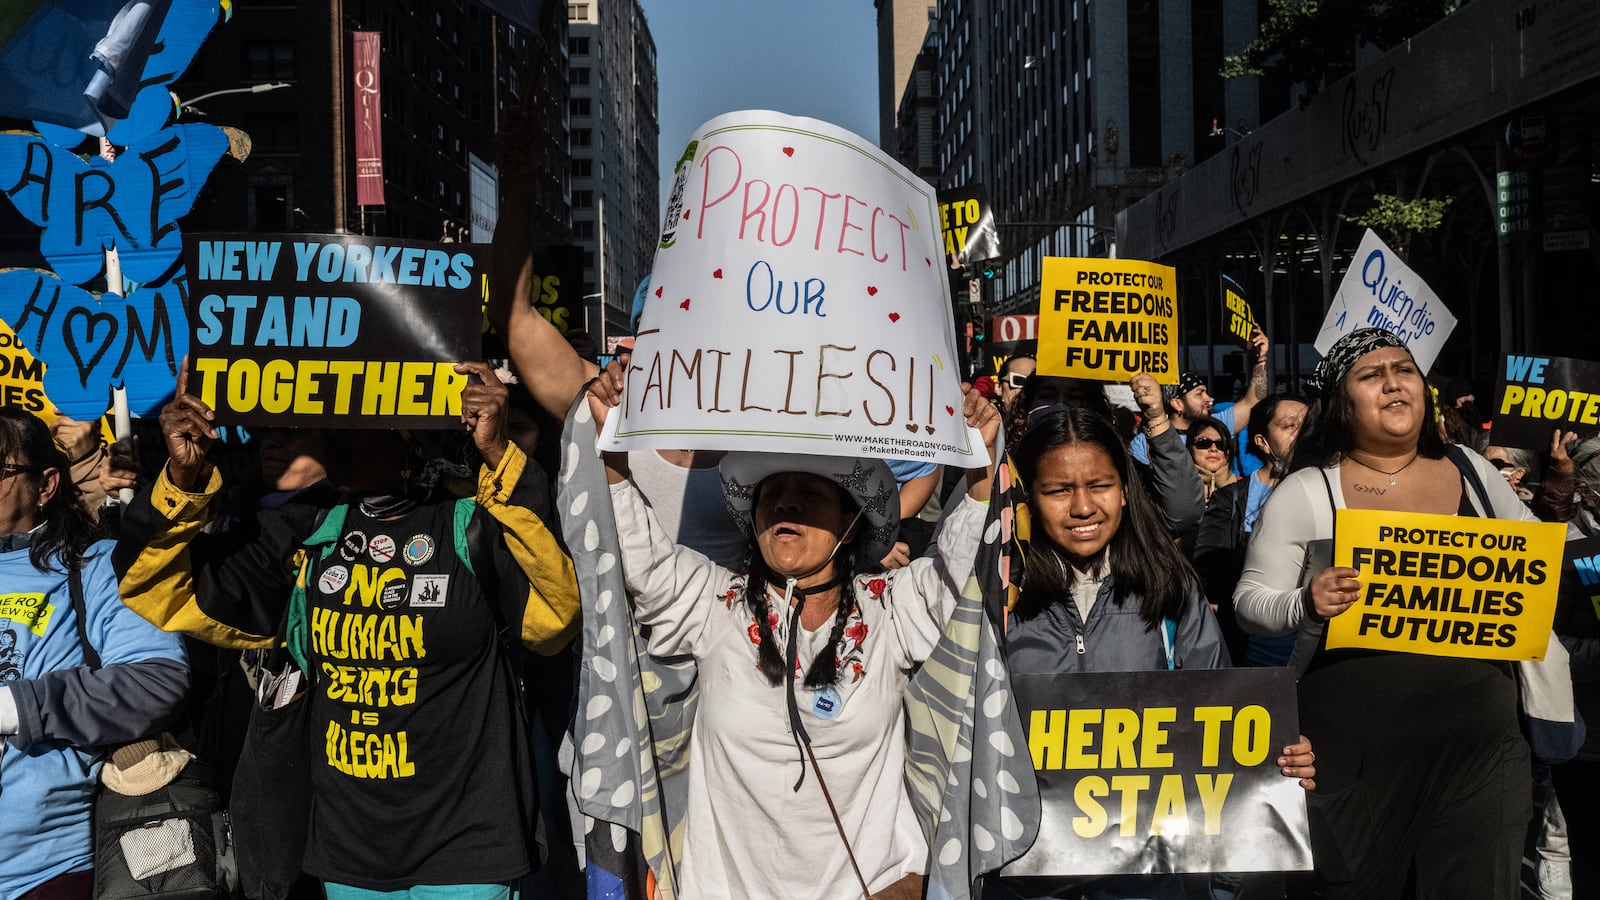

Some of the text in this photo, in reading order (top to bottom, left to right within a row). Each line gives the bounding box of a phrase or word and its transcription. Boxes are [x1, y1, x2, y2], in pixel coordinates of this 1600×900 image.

[7, 136, 183, 250] ARE
[697, 145, 912, 272] PROTECT
[952, 198, 981, 227] TO
[198, 241, 475, 290] NEW YORKERS
[1076, 271, 1163, 291] PROTECT OUR
[746, 260, 827, 318] OUR
[1362, 249, 1414, 321] Quien
[1053, 289, 1173, 318] FREEDOMS
[1226, 288, 1247, 319] HERE
[196, 295, 362, 349] STAND
[1066, 319, 1169, 346] FAMILIES
[1230, 313, 1253, 343] STAY
[1066, 346, 1169, 374] FUTURES
[1505, 354, 1551, 385] WE
[195, 357, 469, 417] TOGETHER
[1499, 384, 1600, 426] PROTE
[834, 434, 958, 453] WWW.MAKETHEROADNY.ORG
[860, 445, 937, 459] @MaketheRoadNY
[373, 537, 388, 546] STOP
[1378, 525, 1527, 552] PROTECT OUR
[1352, 546, 1547, 586] FREEDOMS
[1364, 582, 1525, 617] FAMILIES
[311, 606, 426, 661] HUMAN
[1358, 612, 1518, 648] FUTURES
[322, 661, 419, 708] BEING
[350, 709, 380, 726] IS
[325, 719, 416, 780] ILLEGAL
[1028, 704, 1272, 771] HERE TO
[1071, 773, 1235, 839] STAY
